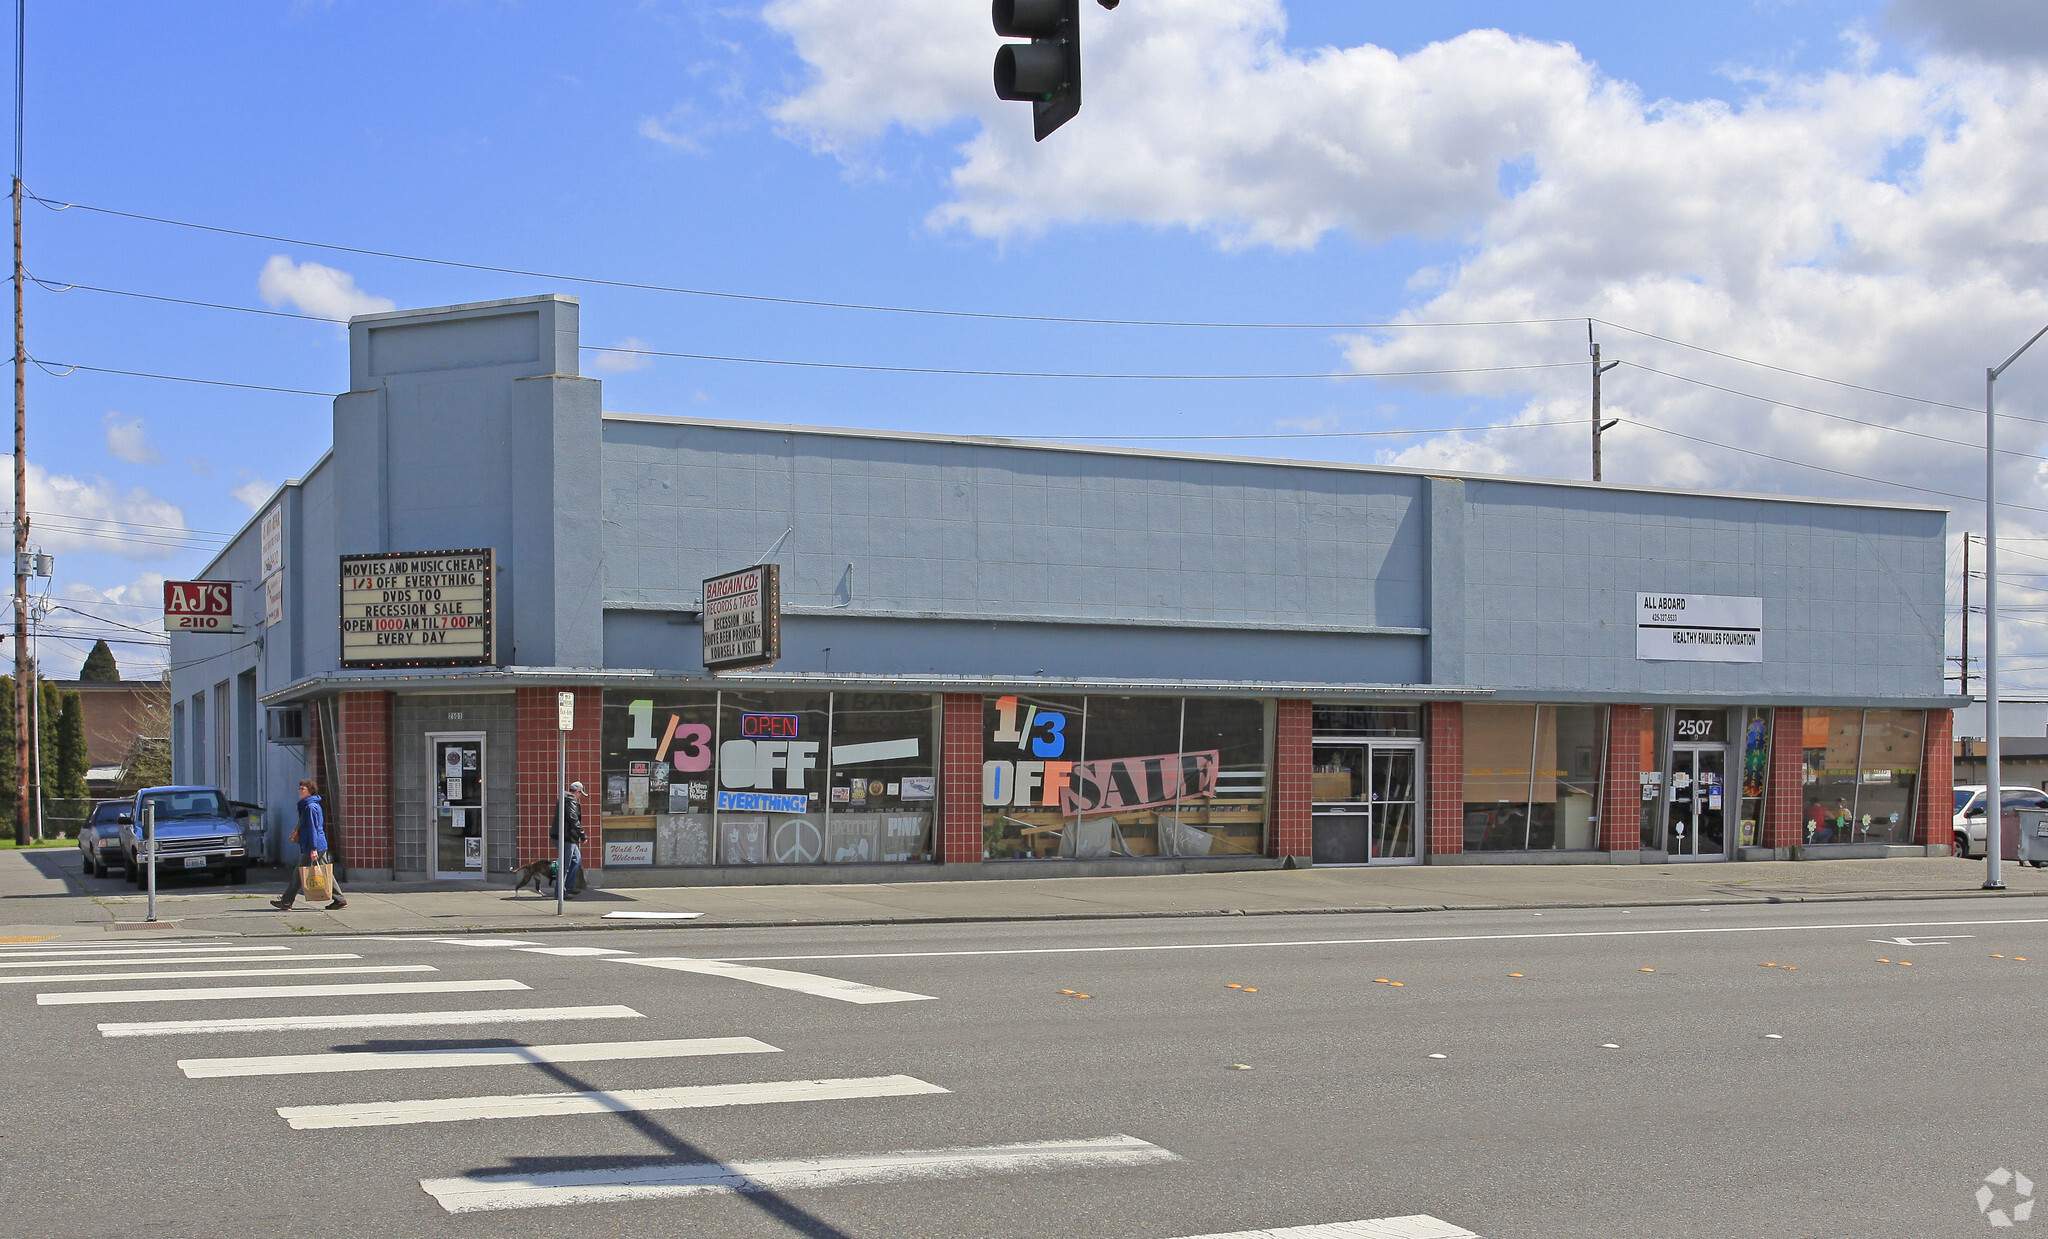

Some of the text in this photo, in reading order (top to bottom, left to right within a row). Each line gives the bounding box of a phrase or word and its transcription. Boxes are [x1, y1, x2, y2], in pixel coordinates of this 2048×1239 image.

[344, 558, 483, 576] MOVIES AND MUSIC CHEAP
[353, 573, 475, 590] 1/3 OFF EVERYTHING
[707, 577, 742, 598] BARGAIN
[168, 585, 228, 612] AJ'S
[383, 589, 441, 602] DVDS TOO
[707, 593, 758, 616] RECORDS & TAPES
[1644, 597, 1686, 610] ALL ABOARD
[366, 602, 462, 617] RECESSION SALE
[180, 617, 218, 628] 2110
[344, 620, 372, 631] OPEN
[422, 617, 439, 629] TIL
[714, 611, 754, 630] RECESSION SALE
[377, 631, 446, 644] EVERY DAY
[720, 629, 731, 644] BEEN
[732, 624, 760, 641] PROMISING
[1672, 632, 1756, 646] HEALTHY FAMILIES FOUNDATION
[711, 640, 756, 659] YOURSELF A VISIT
[744, 716, 796, 736] OPEN
[994, 696, 1066, 758] 1/3
[1678, 720, 1713, 735] 2507
[627, 700, 712, 772] 1/3
[720, 739, 820, 789] OFF
[982, 760, 1072, 806] OFF
[1069, 754, 1214, 812] SALE
[887, 816, 922, 837] PINK
[611, 845, 632, 853] Walk
